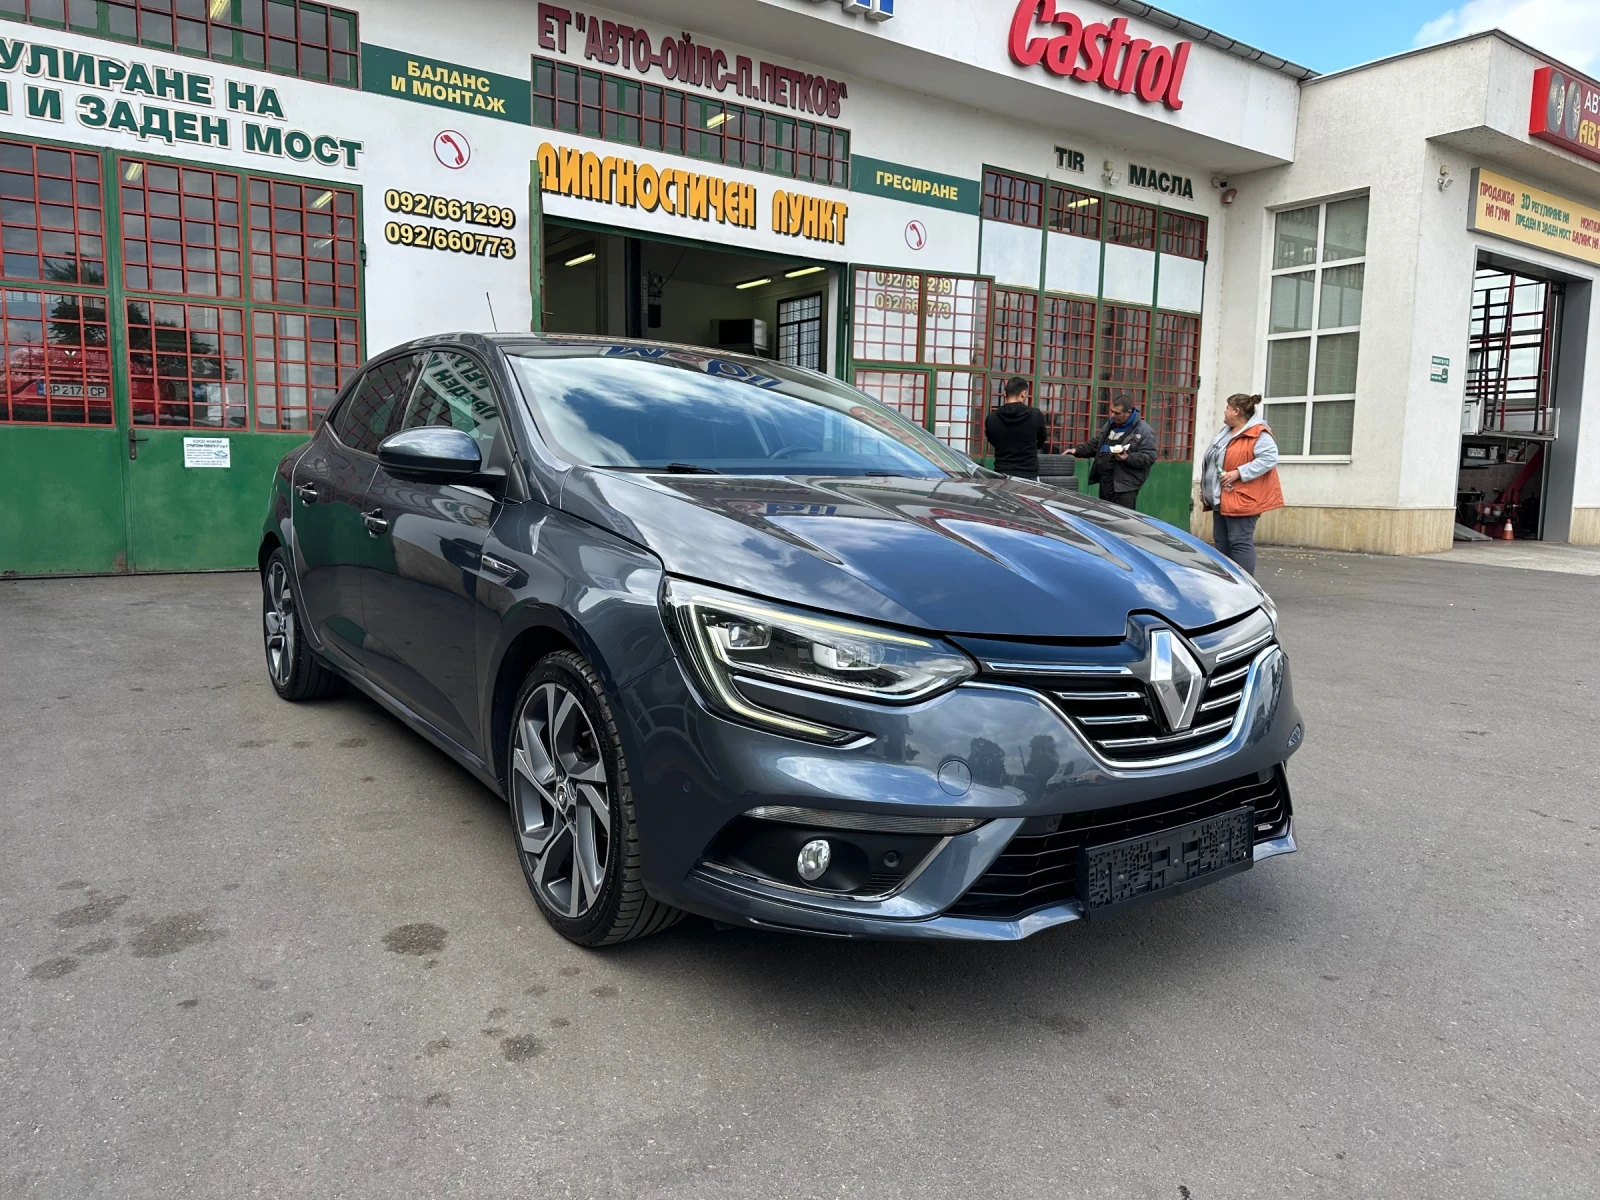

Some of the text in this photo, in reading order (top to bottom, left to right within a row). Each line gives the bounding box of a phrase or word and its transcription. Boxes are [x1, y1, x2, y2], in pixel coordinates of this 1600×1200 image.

[538, 2, 571, 54] ЕТ
[1008, 0, 1193, 111] Castrol
[407, 60, 491, 93] БАЛАНС
[228, 80, 285, 118] НА
[391, 75, 506, 114] И МОНТАЖ
[1584, 90, 1600, 116] АВ
[27, 85, 62, 120] И
[79, 95, 229, 147] ЗАДЕН
[245, 122, 363, 169] МОСТ
[876, 170, 958, 201] ГРЕСИРАНЕ
[1054, 145, 1194, 201] TIR МАСЛА
[385, 189, 516, 230] 092/661299
[537, 142, 848, 245] ДИАГНОСТИЧЕН ПУНКТ
[1480, 182, 1515, 206] ПРОДАЖБА
[1521, 192, 1570, 224] 3D РЕГУЛИРАНЕ НА
[1485, 203, 1511, 223] НА ГУМИ
[1515, 212, 1571, 241] ПРЕДЕН И ЗАДЕН МОСТ
[385, 222, 516, 260] 092/660773
[1572, 230, 1591, 247] БАЛАНС
[876, 271, 953, 296] 092/66299
[875, 293, 952, 320] 092/66773
